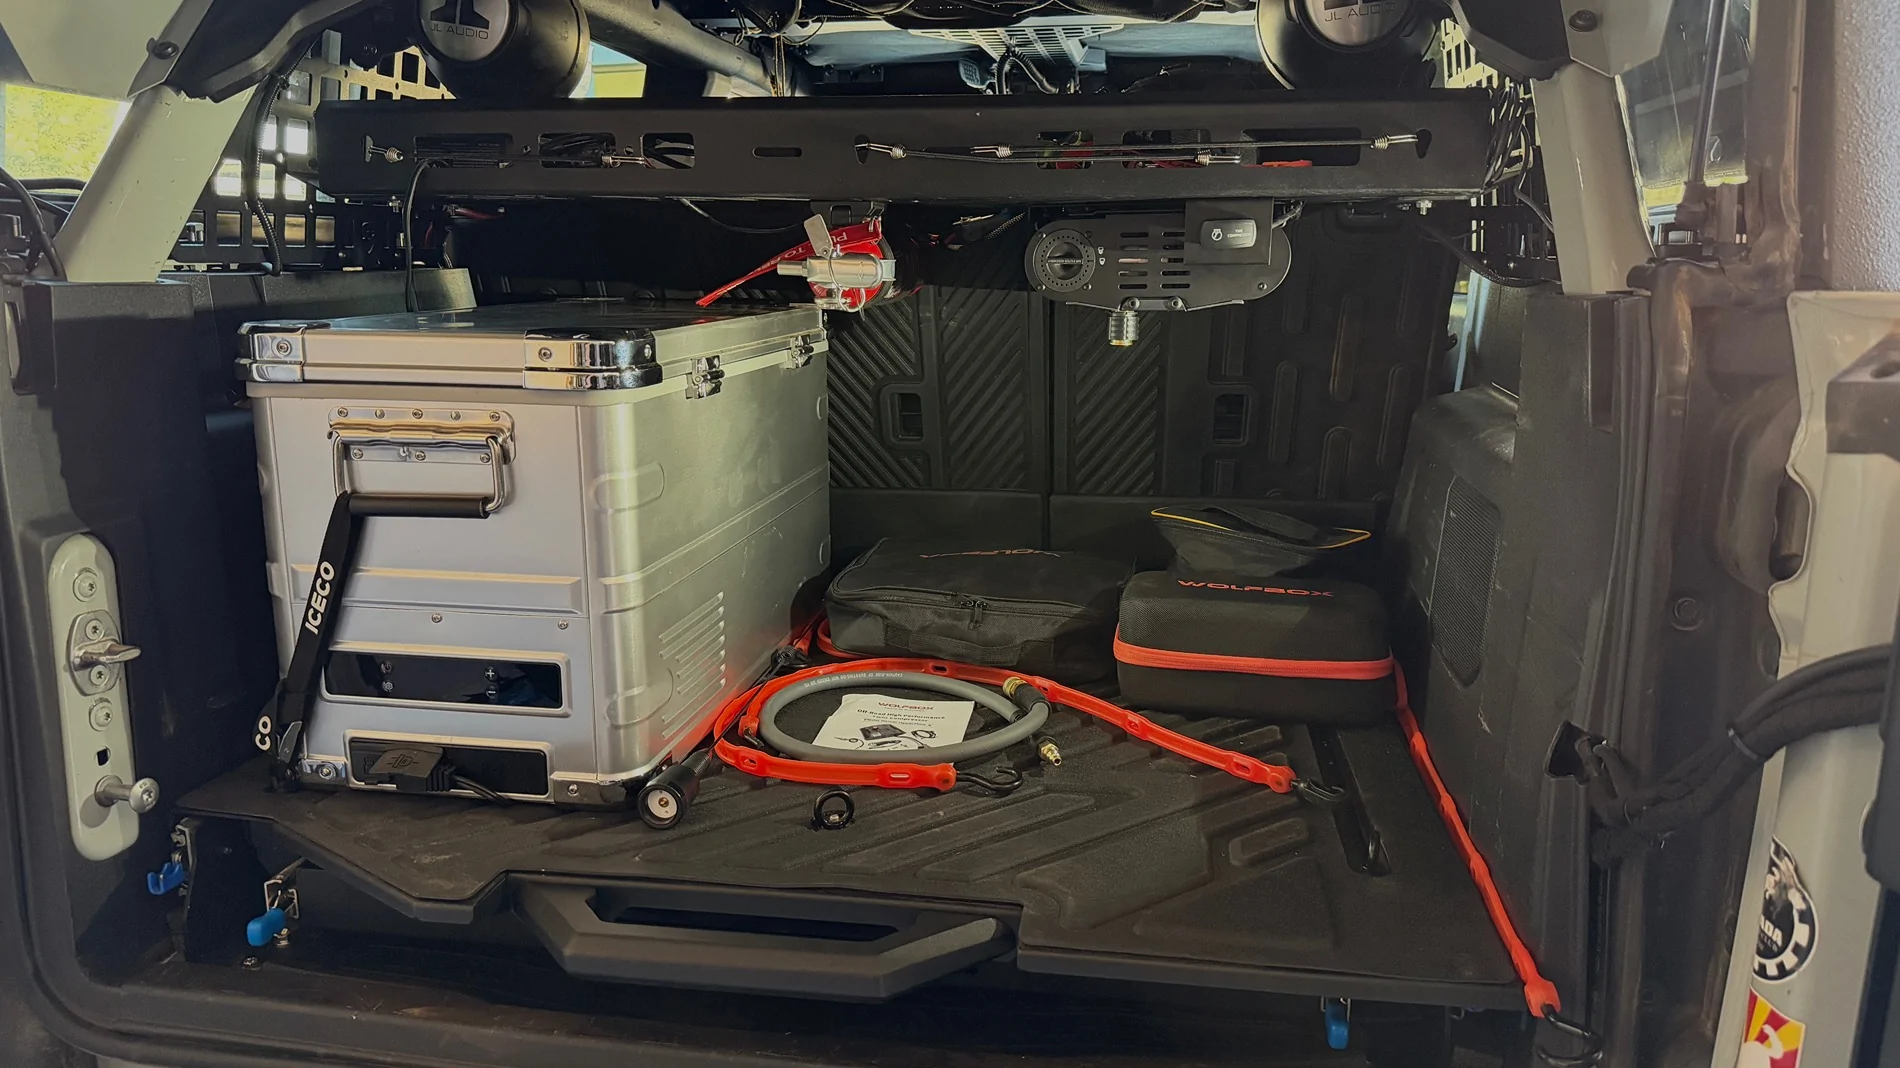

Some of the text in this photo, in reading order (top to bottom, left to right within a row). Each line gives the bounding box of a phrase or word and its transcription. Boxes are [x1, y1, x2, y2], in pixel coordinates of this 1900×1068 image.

[1325, 2, 1396, 22] JL AUDIO
[429, 23, 489, 40] JL AUDIO
[784, 247, 806, 258] TO
[1178, 579, 1334, 597] WOLFBOX
[305, 561, 335, 635] ICECO
[878, 702, 934, 710] WOLFBOX
